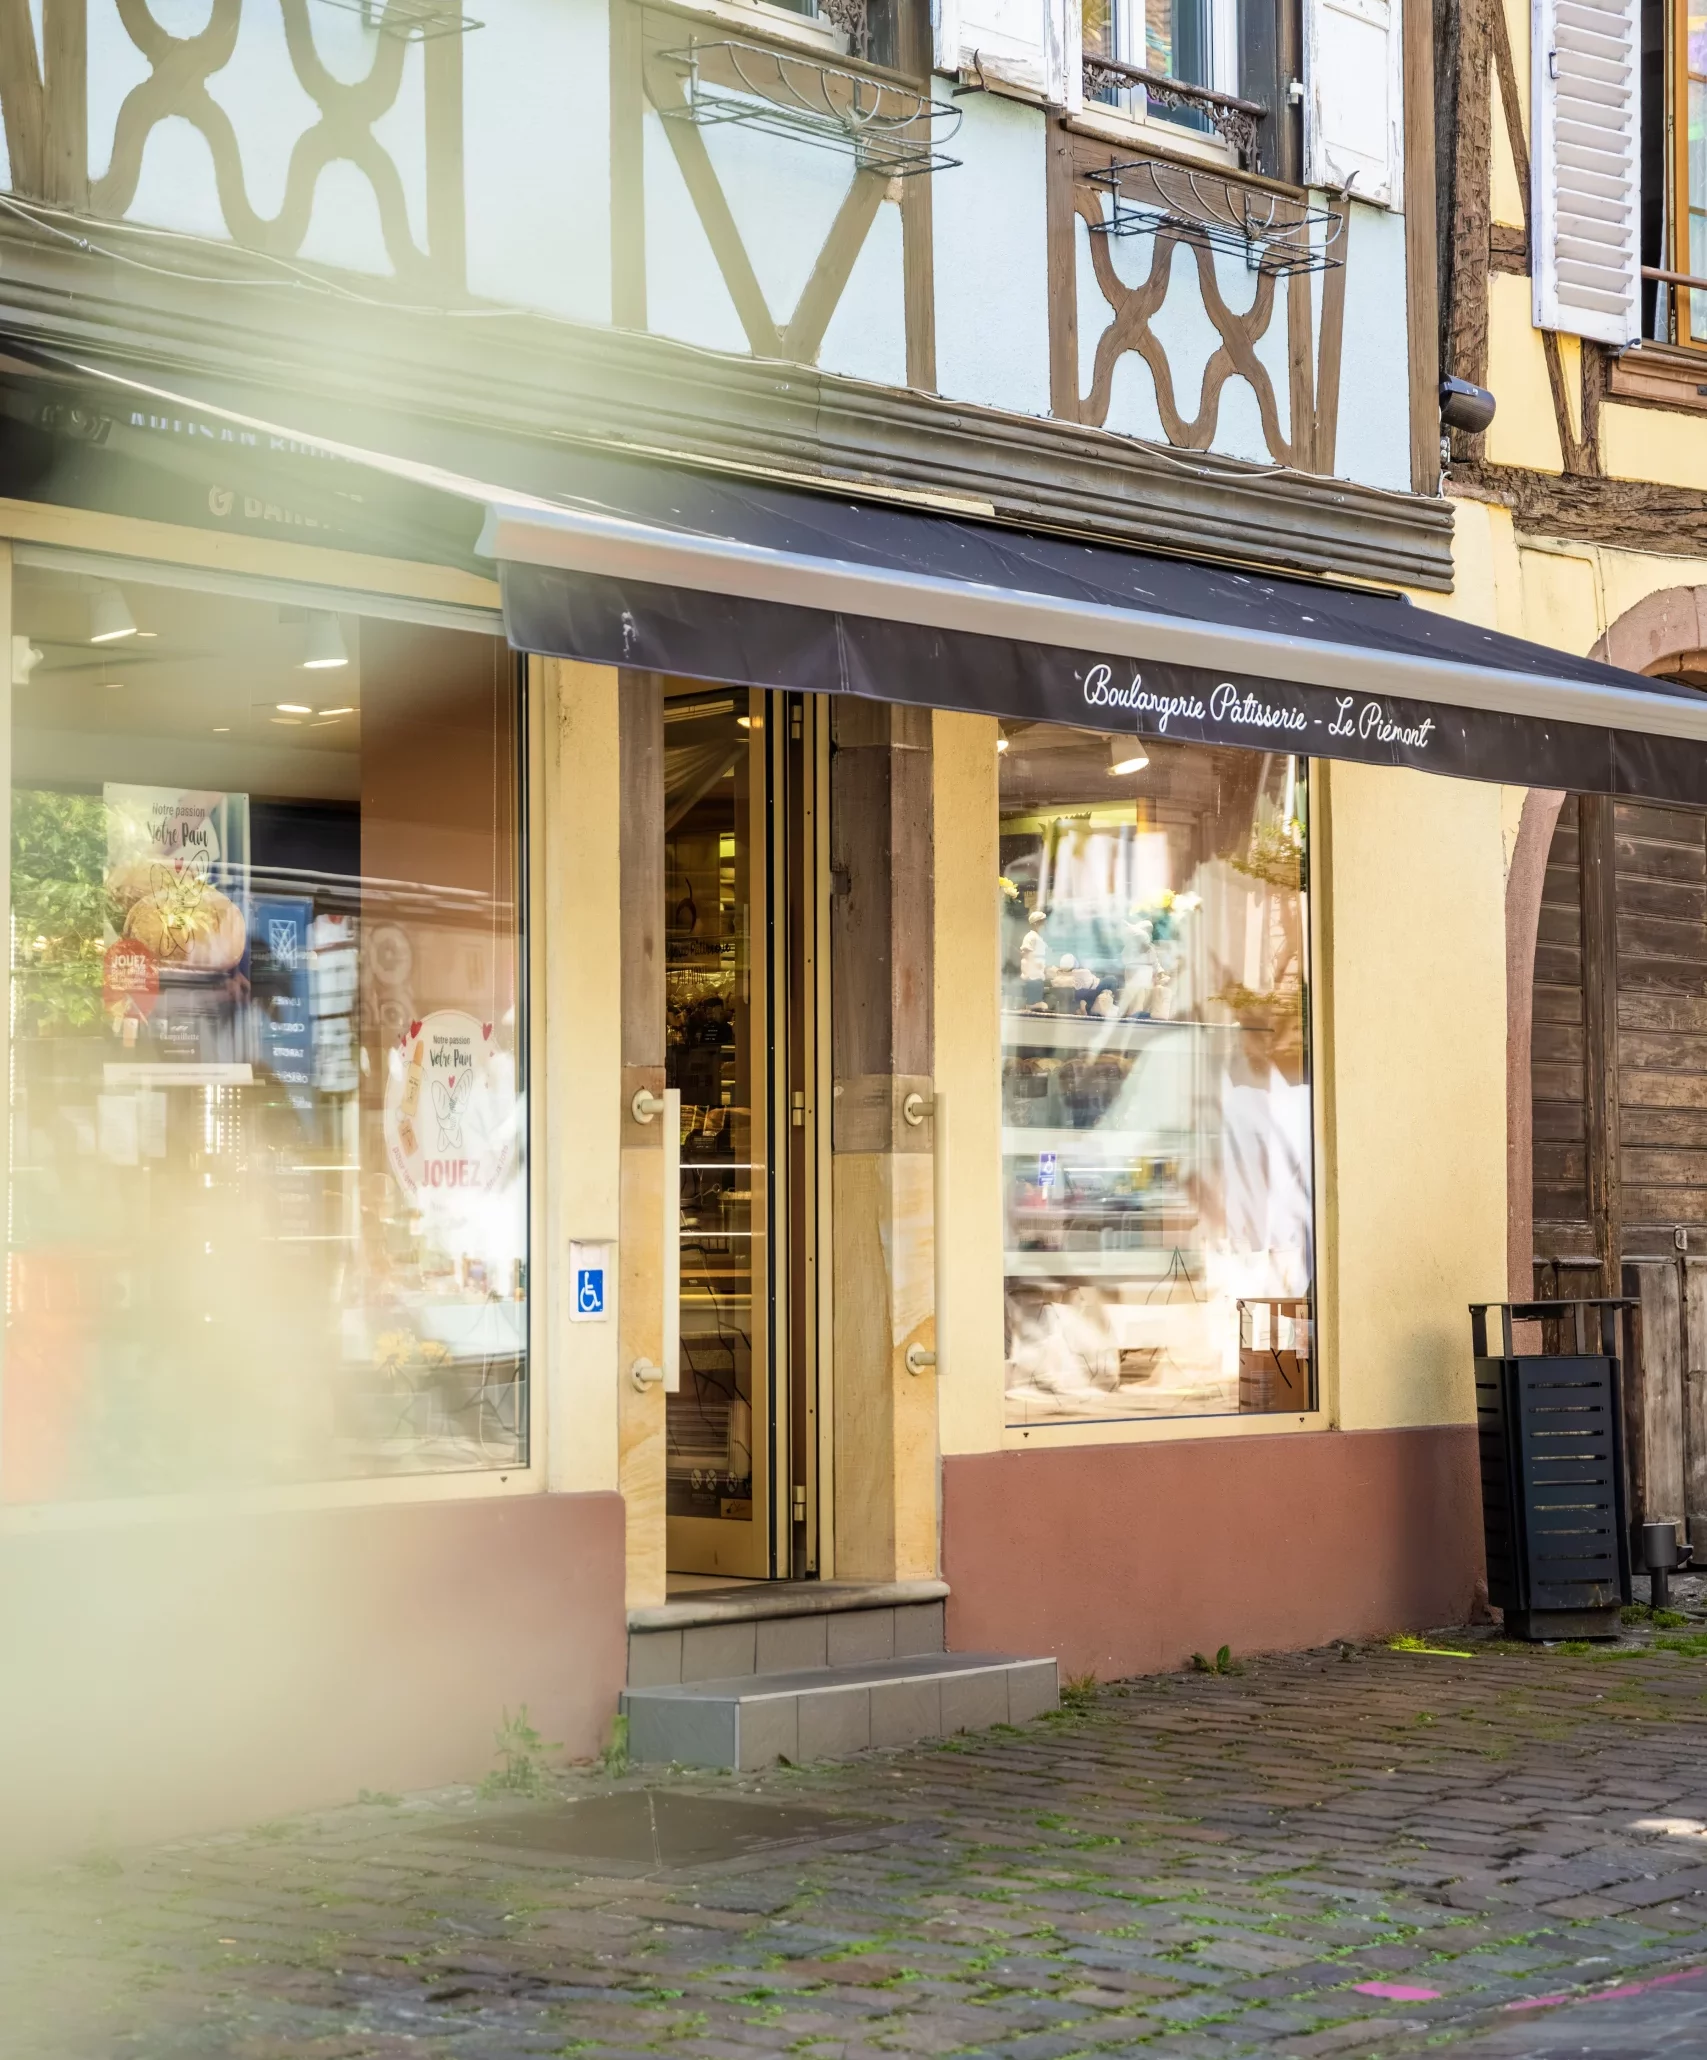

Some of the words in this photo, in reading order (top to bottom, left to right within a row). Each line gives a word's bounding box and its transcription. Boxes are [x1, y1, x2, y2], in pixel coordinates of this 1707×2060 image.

[1083, 663, 1206, 733] Boulangerie
[1210, 682, 1307, 731] Pâtisserie
[1328, 696, 1355, 737] Le
[1359, 701, 1436, 748] Piémont
[152, 803, 174, 815] Notre
[175, 805, 205, 818] passion
[147, 817, 177, 846] Votre
[182, 822, 208, 847] Pain
[111, 954, 146, 968] JOUEZ
[433, 1035, 448, 1044] Notre
[449, 1036, 471, 1046] passion
[429, 1045, 451, 1067] Votre
[453, 1049, 472, 1067] Pain
[421, 1159, 481, 1189] JOUEZ
